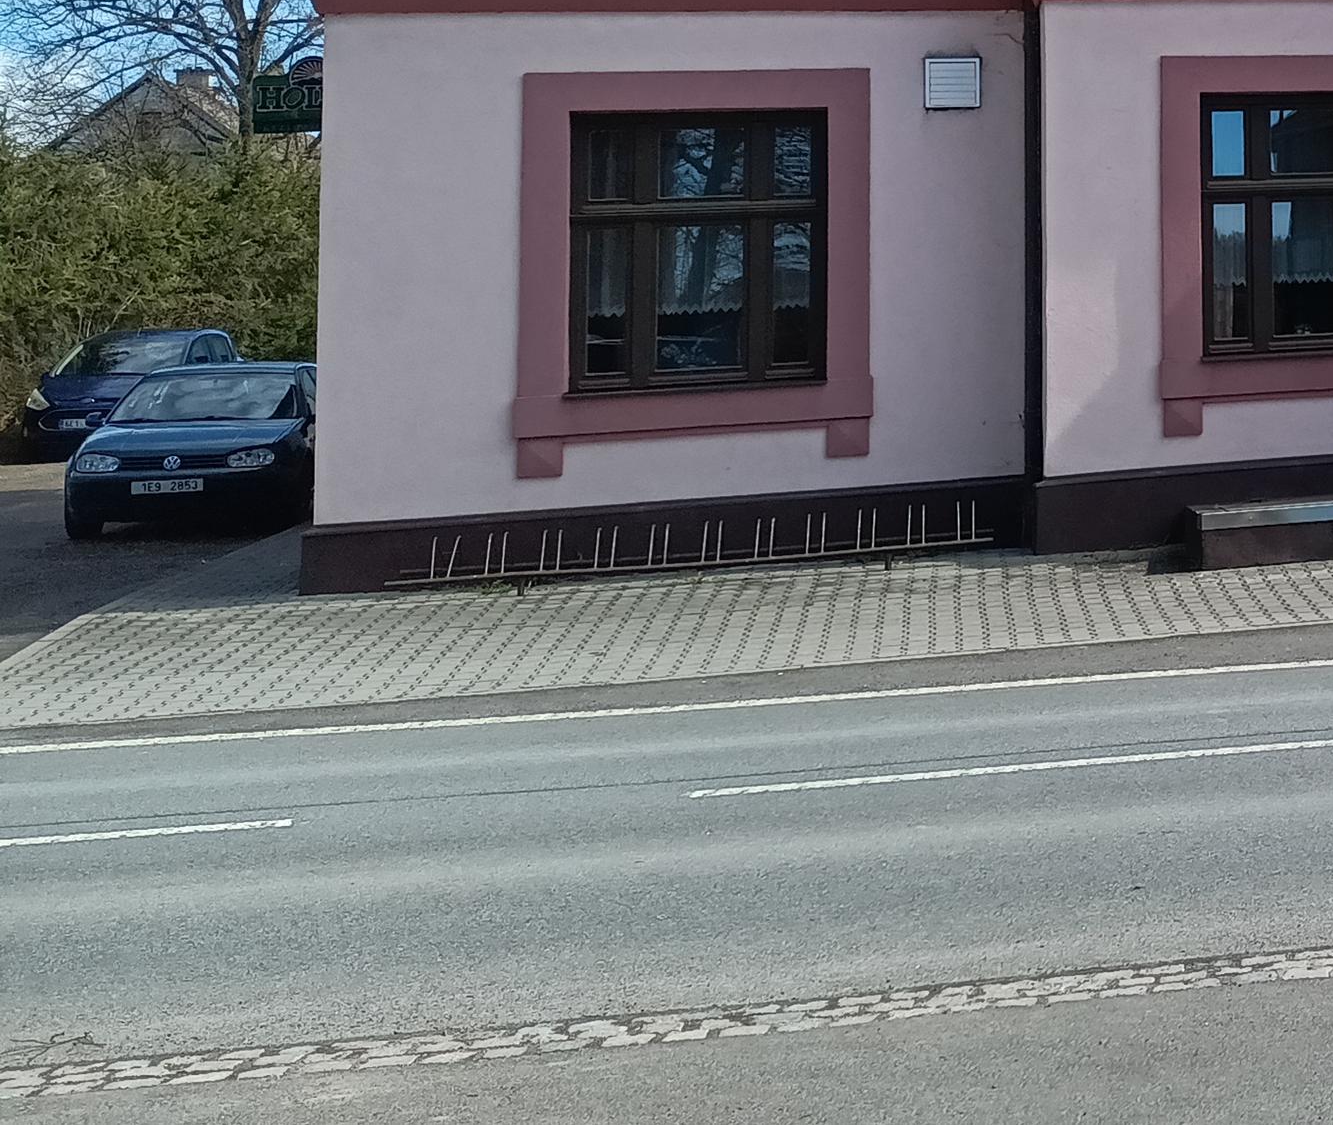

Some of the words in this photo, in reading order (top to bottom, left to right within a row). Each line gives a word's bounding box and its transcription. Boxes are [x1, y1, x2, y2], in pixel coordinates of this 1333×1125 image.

[257, 84, 323, 112] HOL
[142, 481, 161, 492] 1E9
[169, 480, 198, 492] 2853
